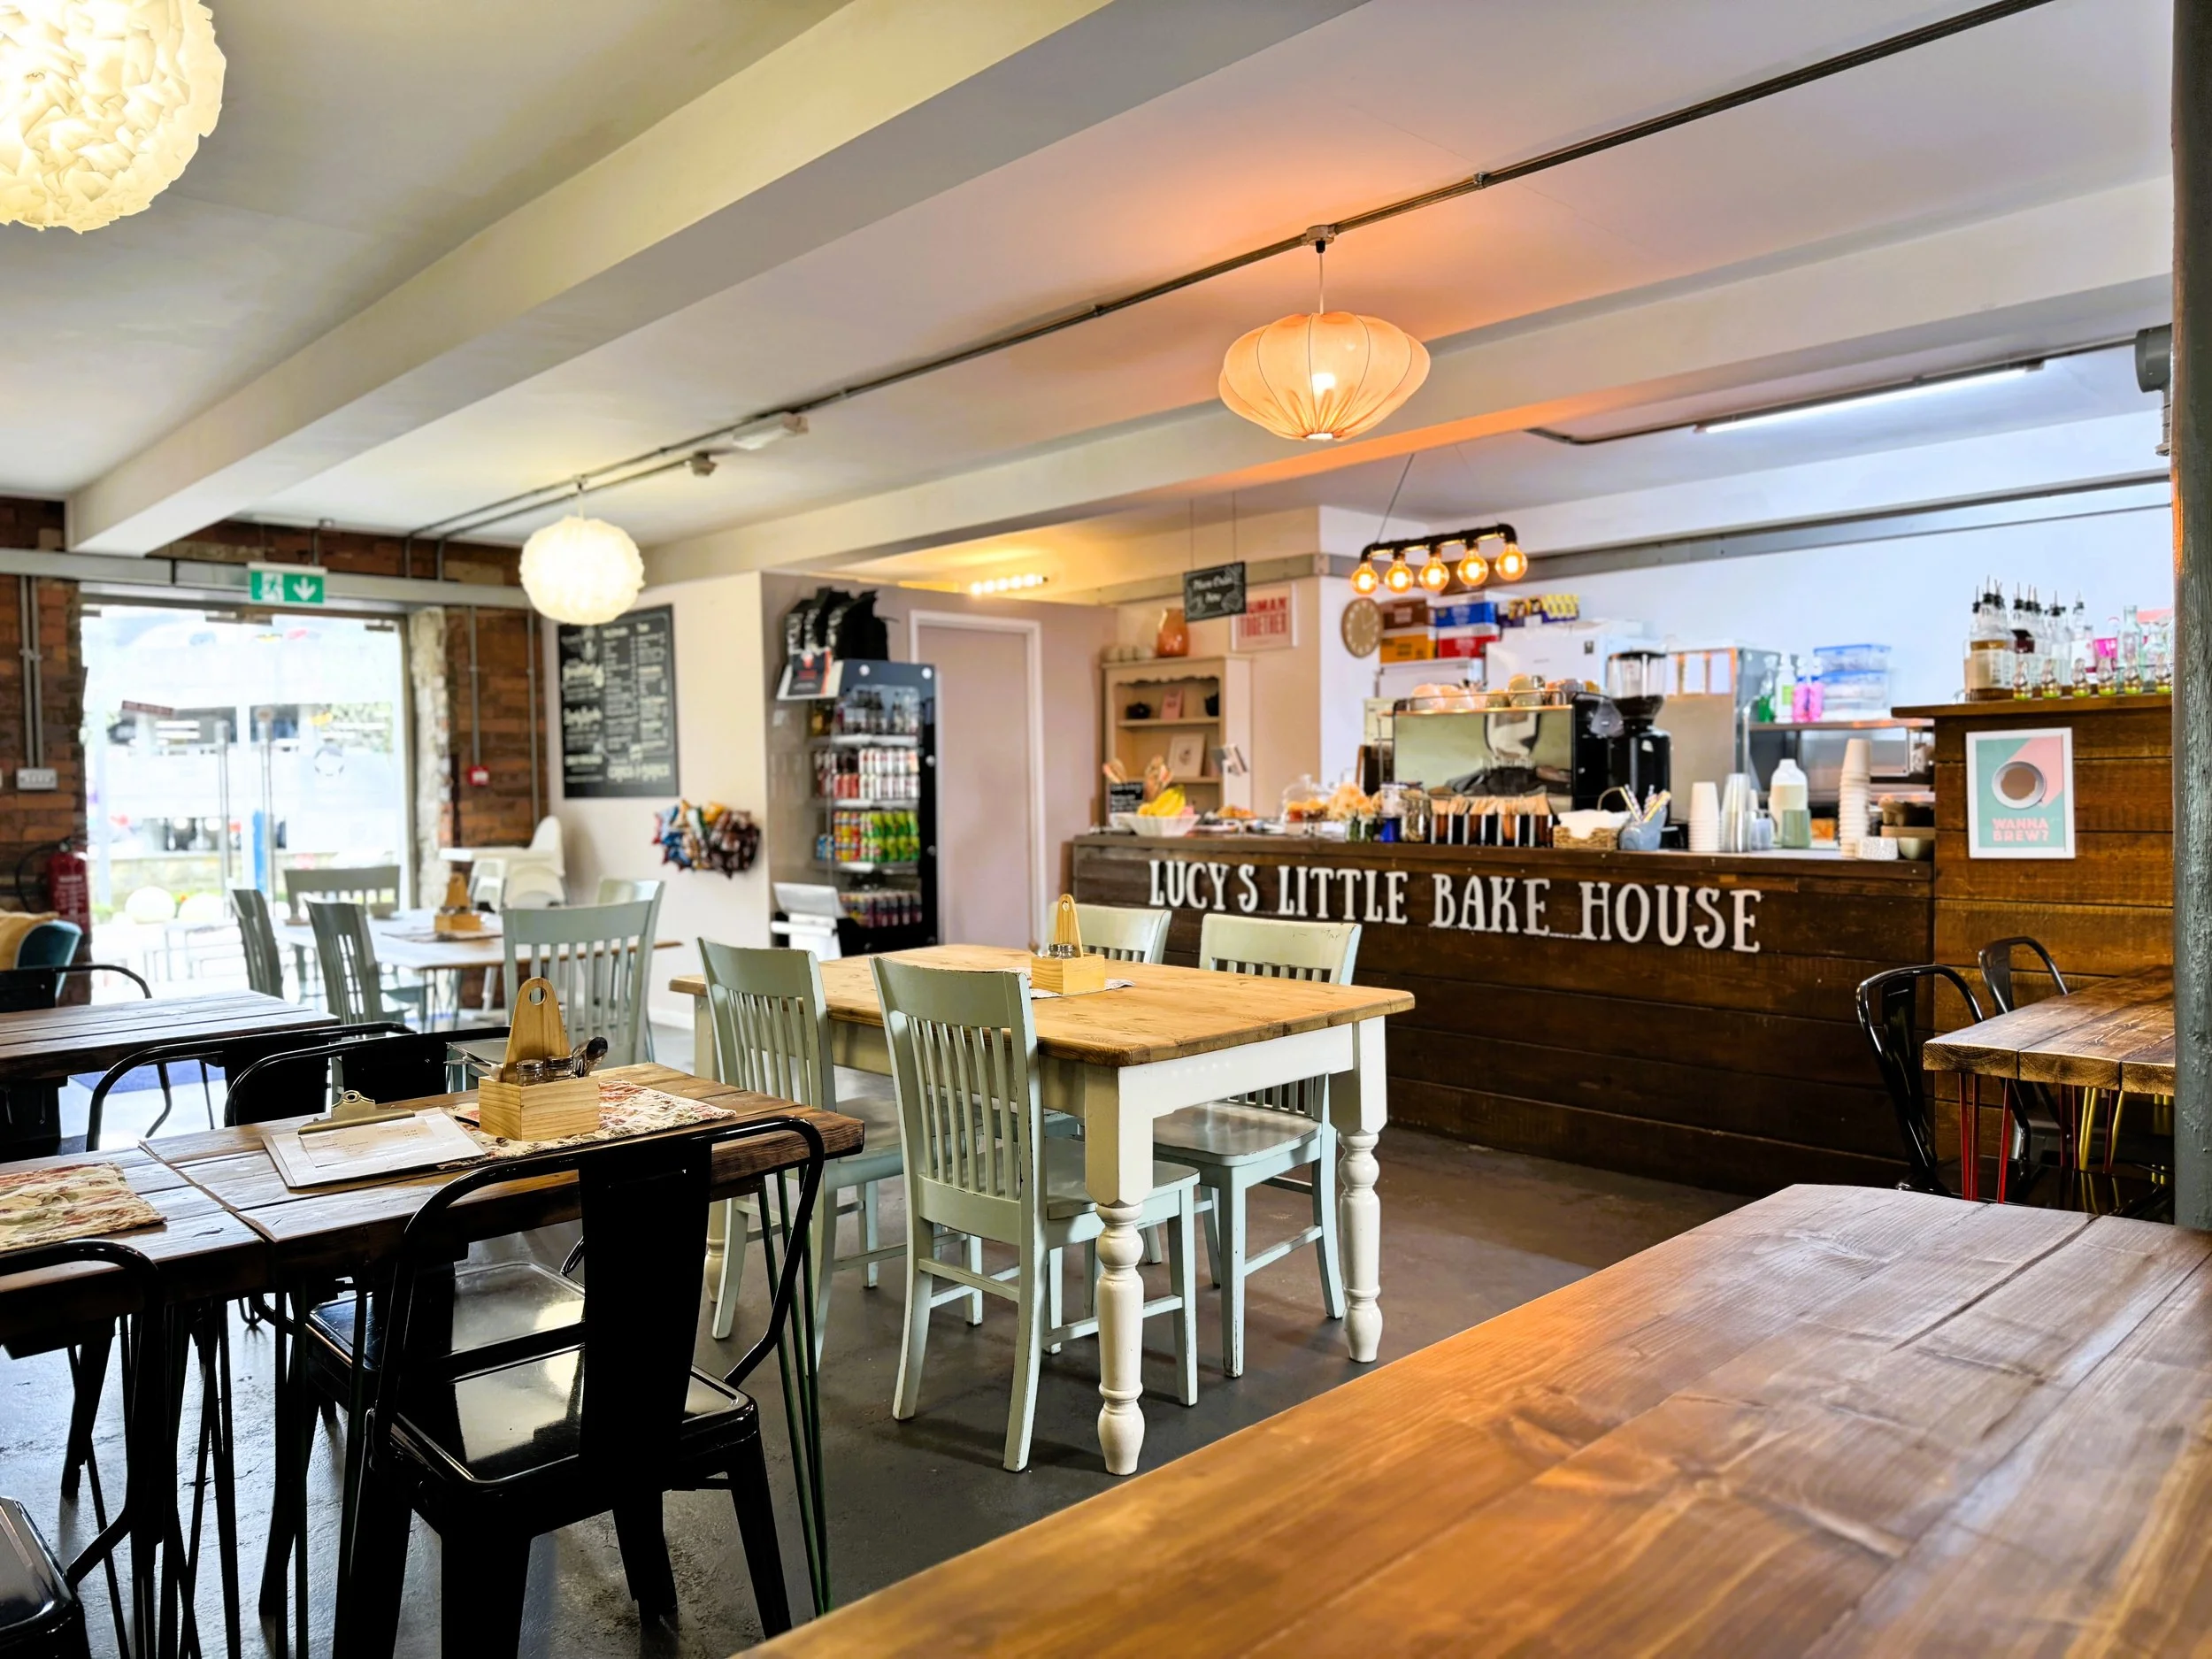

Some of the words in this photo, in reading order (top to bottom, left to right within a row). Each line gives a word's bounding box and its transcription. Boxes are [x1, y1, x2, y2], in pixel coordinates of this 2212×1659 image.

[1993, 818, 2048, 830] WANNA
[1993, 830, 2049, 842] BREW?
[1277, 864, 1409, 924] LITTLE
[1429, 872, 1551, 935] BAKE
[1580, 881, 1763, 954] HOUSE
